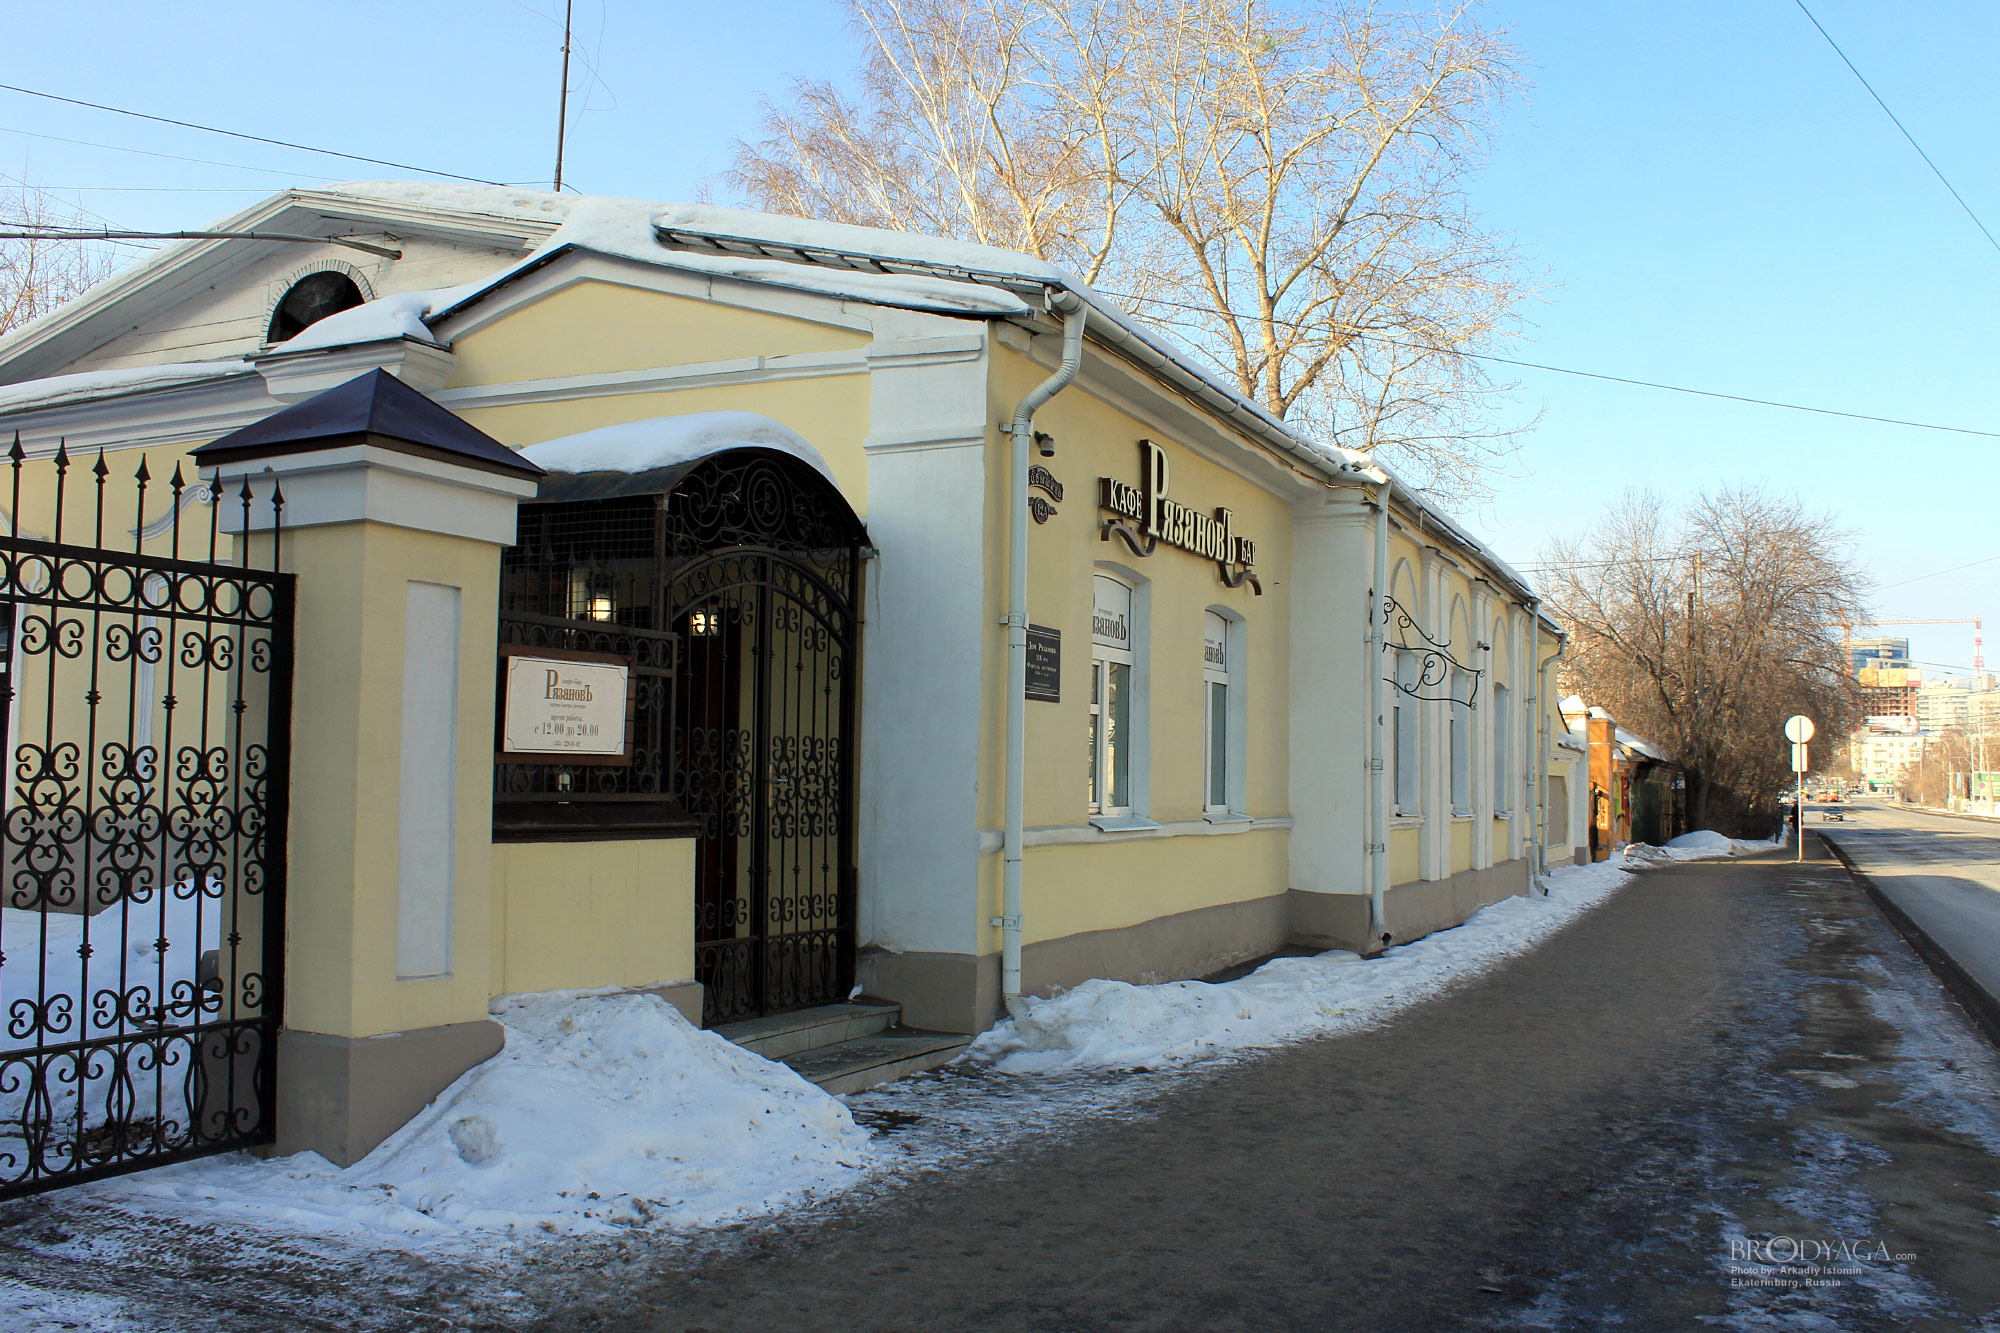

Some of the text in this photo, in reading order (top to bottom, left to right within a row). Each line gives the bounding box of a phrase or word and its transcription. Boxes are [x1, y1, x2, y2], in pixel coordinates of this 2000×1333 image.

[1109, 477, 1143, 520] КАФЕ
[1241, 536, 1257, 567] БАР
[542, 721, 565, 735] 12.00
[577, 723, 599, 737] 20.00
